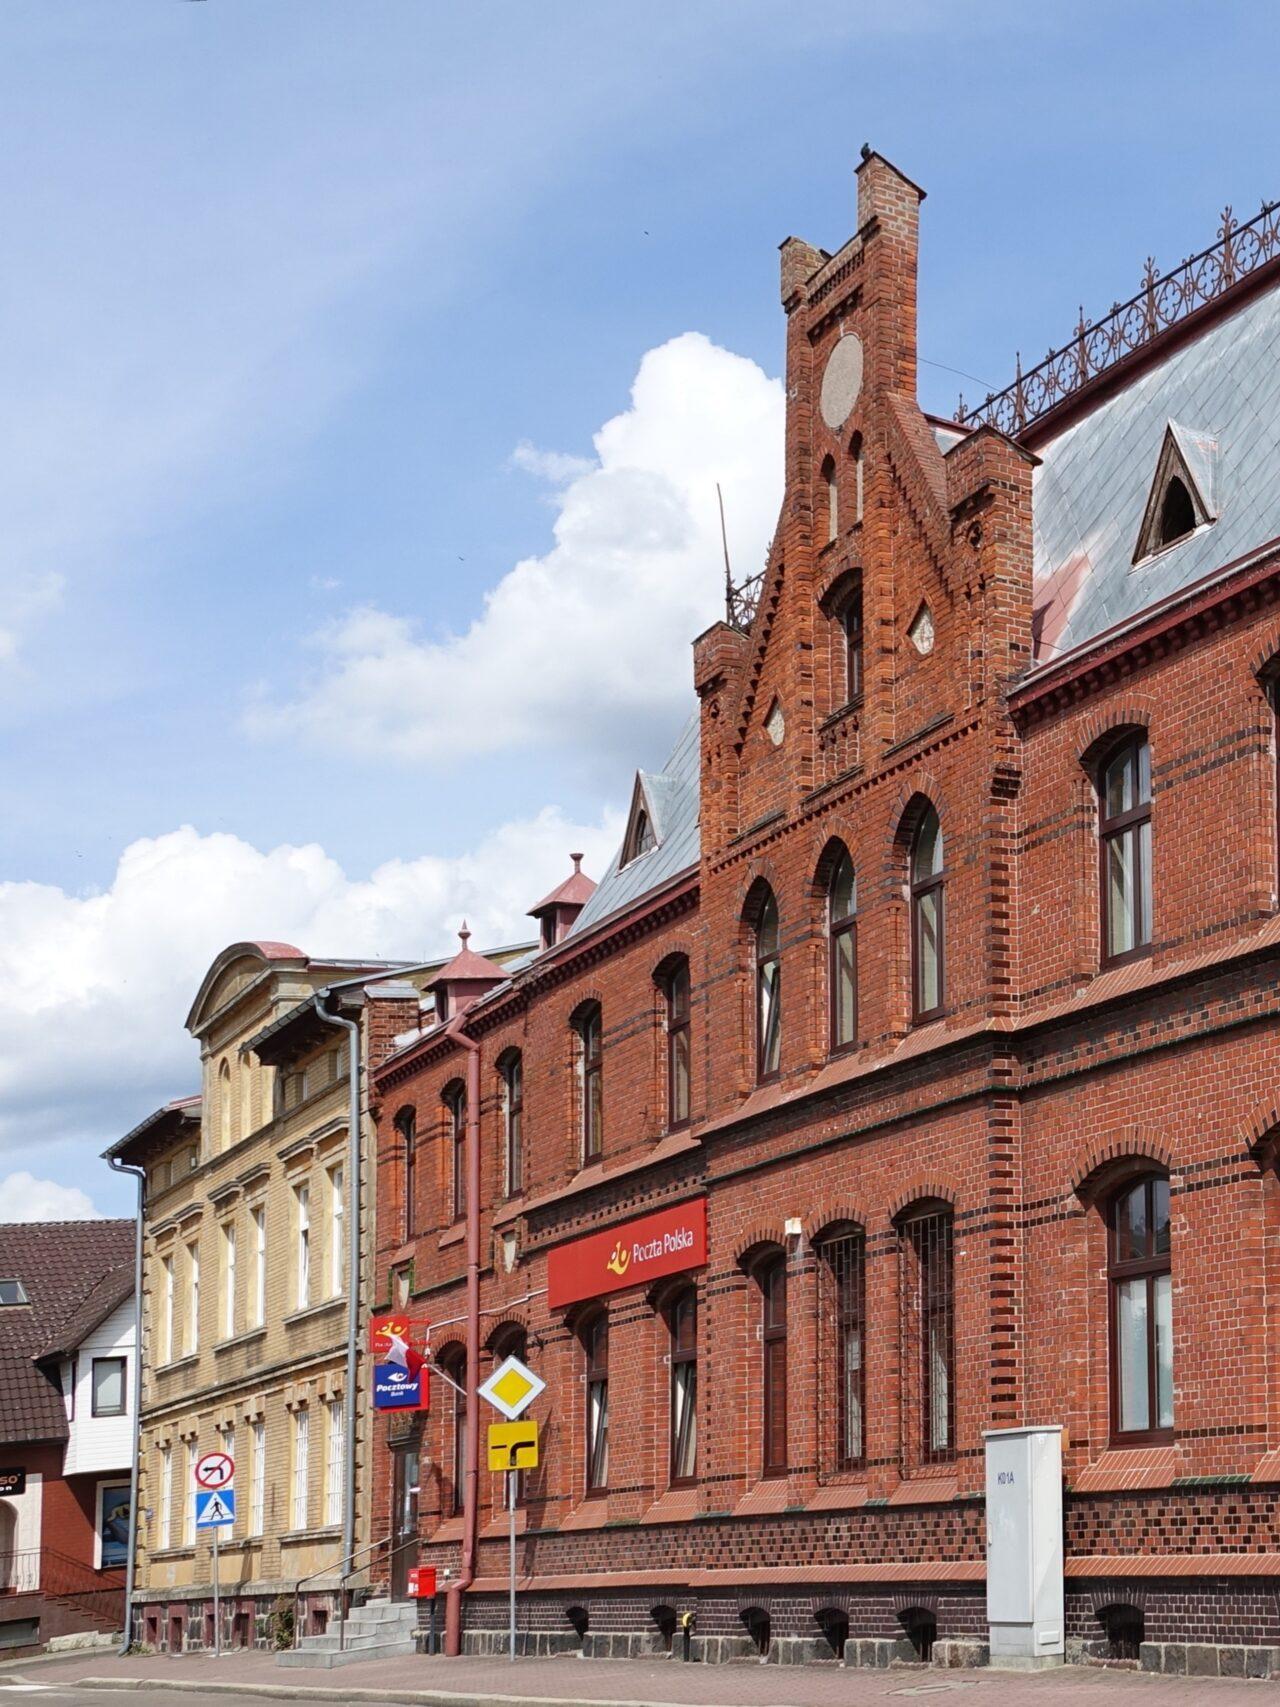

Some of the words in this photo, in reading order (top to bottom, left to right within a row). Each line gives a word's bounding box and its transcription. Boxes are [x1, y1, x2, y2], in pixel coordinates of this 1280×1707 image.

[633, 1240, 663, 1263] Poczta
[663, 1227, 694, 1254] Polska
[376, 1383, 419, 1392] Pocztowy
